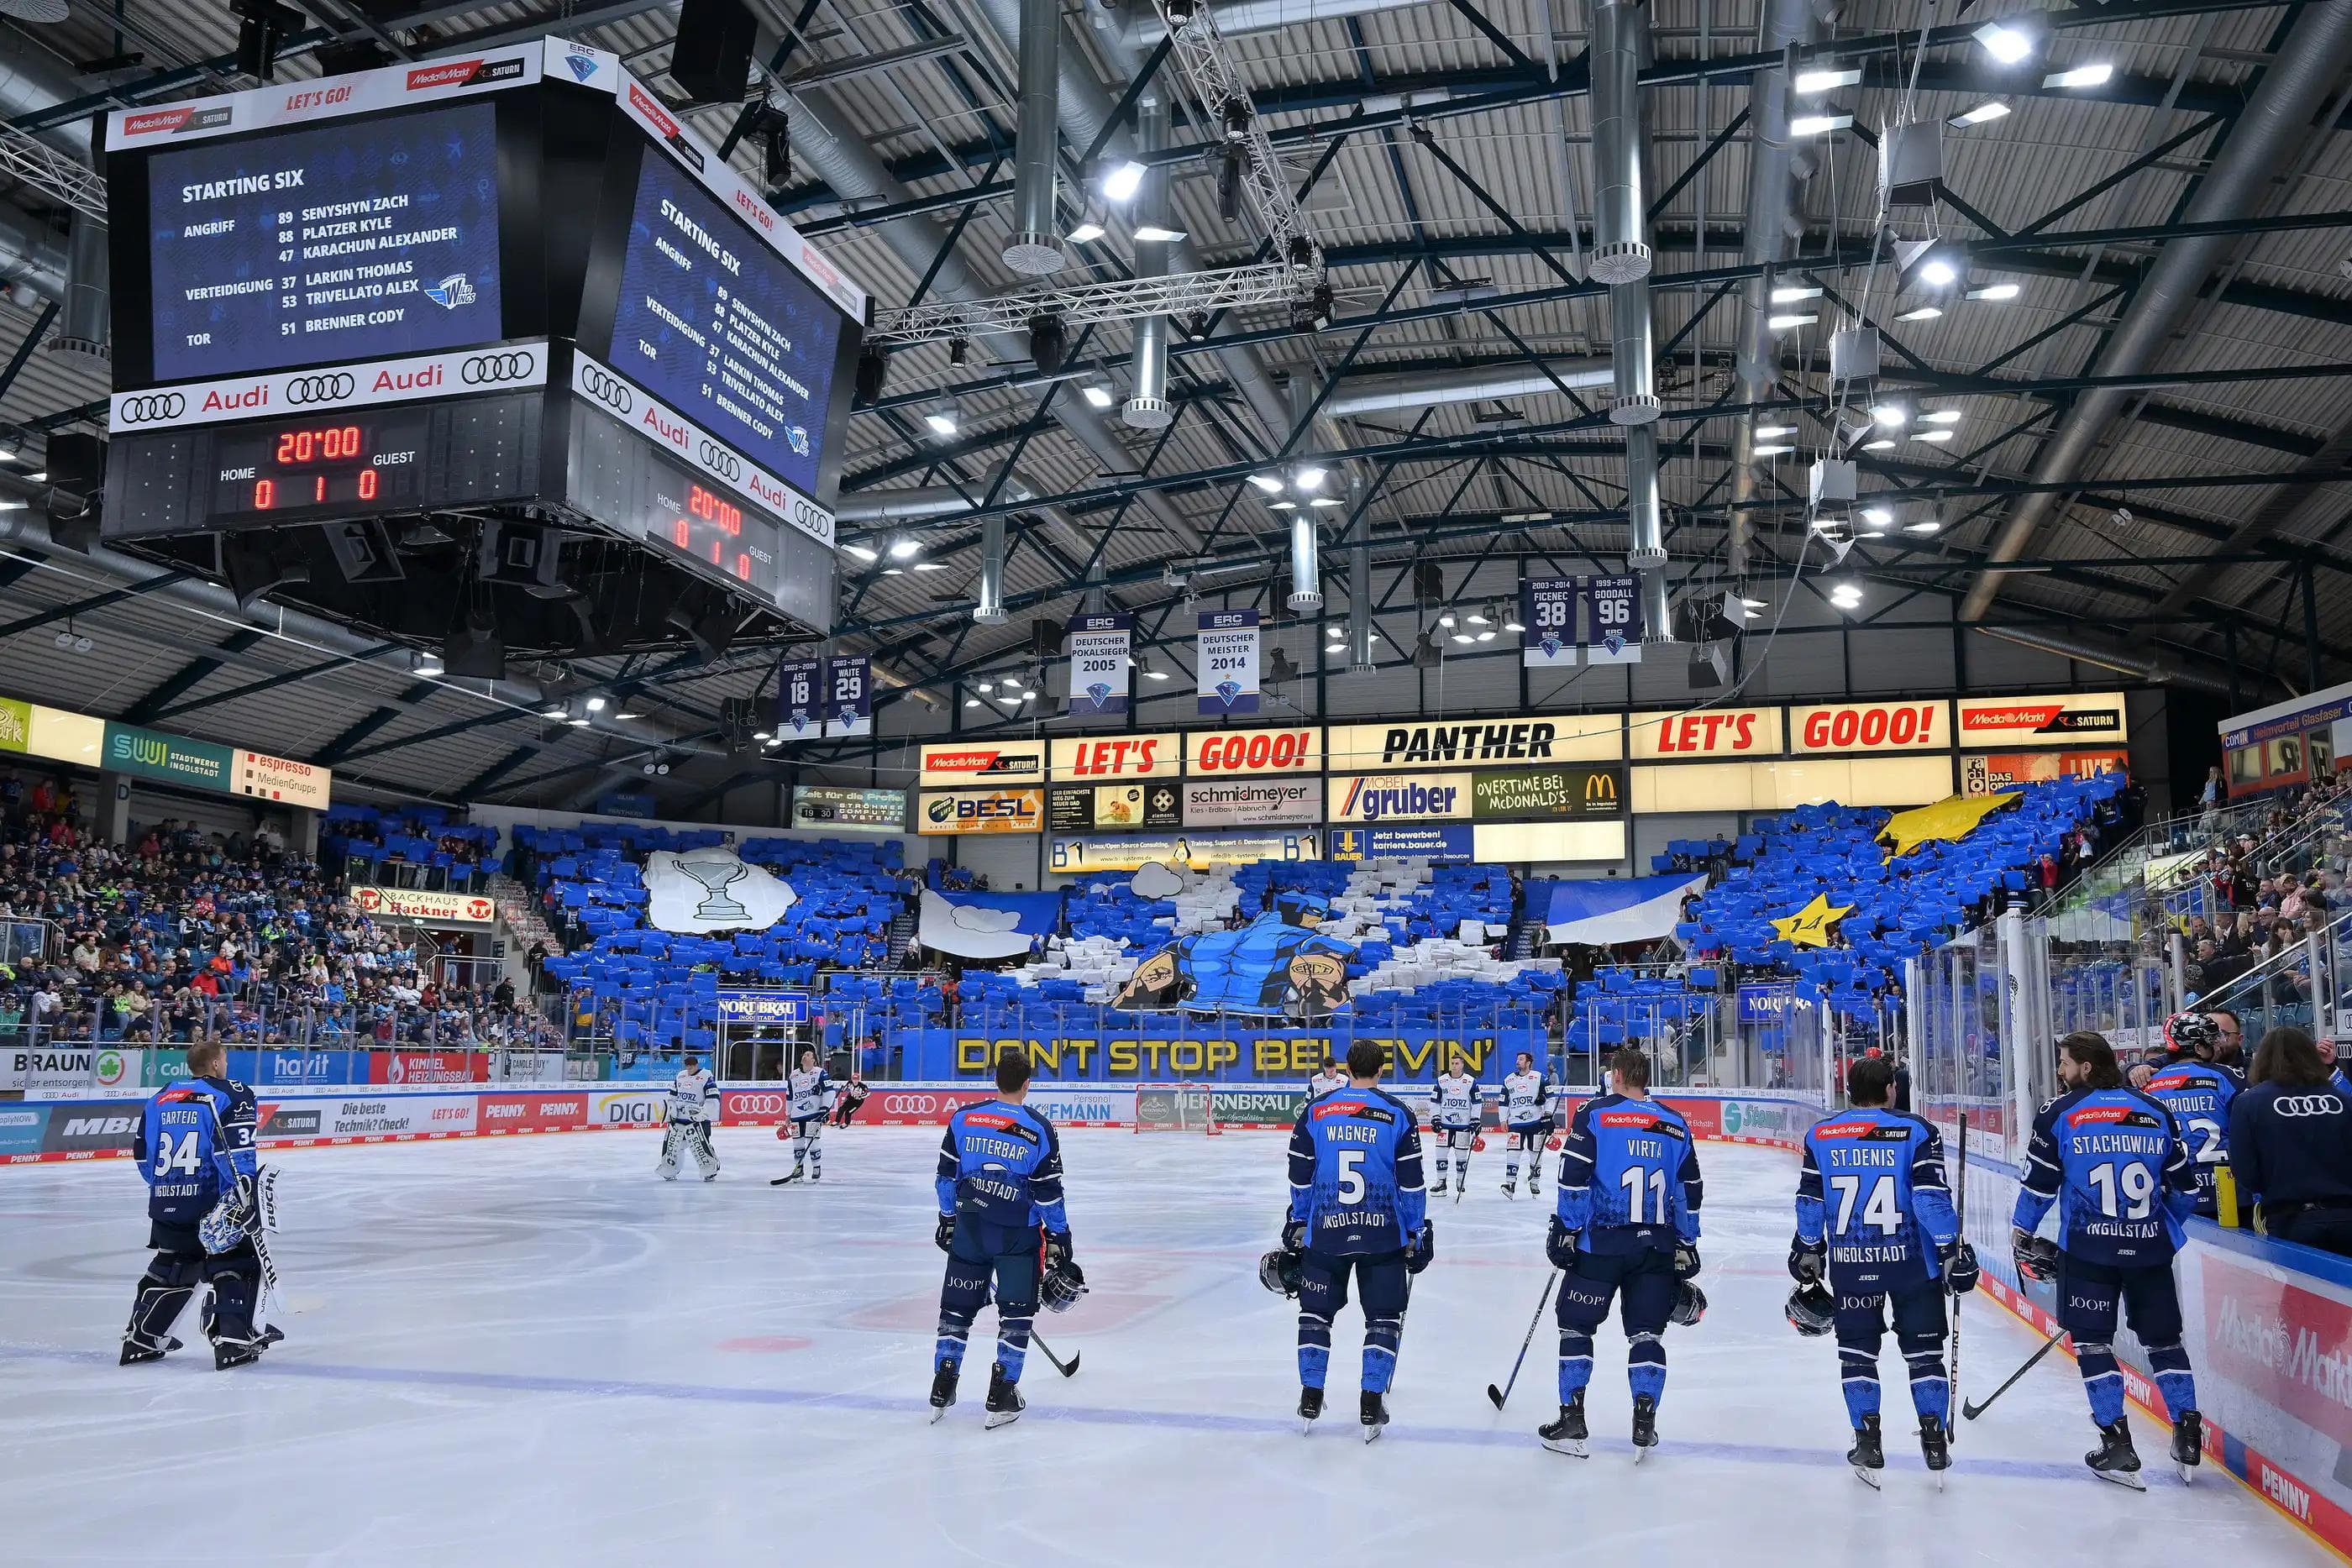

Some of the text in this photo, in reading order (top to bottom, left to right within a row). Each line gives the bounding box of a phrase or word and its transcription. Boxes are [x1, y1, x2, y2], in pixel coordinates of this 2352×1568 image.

[569, 44, 595, 56] ERC
[492, 64, 520, 77] SATURN
[287, 87, 351, 111] LET'S GO!
[182, 170, 304, 203] STARTING SIX
[278, 195, 408, 225] 89 SENYSHYN ZACH
[184, 219, 235, 238] ANGRIFF
[279, 217, 391, 244] 88 PLATZER KYLE
[661, 199, 742, 276] STARTING SIX
[279, 227, 458, 262] 47 KARACHUN ALEXANDER
[655, 237, 691, 271] ANGRIFF
[186, 261, 412, 301] VERTEIDIGUNG 37 LARKIN THOMAS
[282, 280, 418, 308] 53 TRIVELLATO ALEX
[282, 309, 405, 335] 51 BRENNER CODY
[647, 296, 706, 348] VERTEIDIGUNG
[732, 298, 791, 351] SENYSHYN ZACH
[186, 333, 211, 346] TOR
[729, 314, 780, 360] PLATZER KYLE
[727, 330, 809, 401] KARACHUN ALEXANDER
[372, 364, 443, 393] Audi
[724, 354, 784, 406] LARKIN THOMAS
[202, 385, 269, 412] Audi
[722, 371, 784, 423] TRIVELLATO ALEX
[717, 393, 773, 439] BRENNER CODY
[643, 406, 689, 449] Audi
[373, 452, 415, 464] GUEST
[221, 469, 255, 481] HOME
[749, 475, 786, 510] Audi
[1534, 592, 1568, 601] FICENEC
[1595, 590, 1633, 599] GOODALL
[1214, 615, 1242, 624] ERC
[1536, 601, 1566, 627] 38
[1599, 600, 1630, 624] 96
[1087, 618, 1115, 627] ERC
[1076, 637, 1124, 646] DEUTSCHER
[1203, 634, 1254, 644] DEUTSCHER
[1072, 648, 1128, 657] POKALSIEGER
[1208, 645, 1249, 654] MEISTER
[838, 669, 859, 677] WAITE
[1083, 659, 1116, 671] 2005
[1211, 657, 1246, 670] 2014
[793, 673, 806, 681] AST
[791, 682, 809, 704] 18
[837, 677, 861, 700] 29
[1804, 706, 1935, 747] GOOO!
[2076, 714, 2114, 726] SATURN
[2253, 706, 2342, 739] Heimvorteil Glasfaser
[1658, 713, 1756, 752] LET'S
[1200, 732, 1310, 771] GOOO!
[1382, 723, 1555, 763] PANTHER
[171, 752, 220, 768] STADTWERKE
[260, 755, 311, 778] espresso
[1009, 760, 1037, 770] SATURN
[1074, 739, 1158, 775] LET'S
[170, 763, 218, 778] INGOLSTADT
[2071, 758, 2113, 779] LIVE
[257, 773, 317, 795] MedienGruppe
[1365, 777, 1407, 788] MÖBEL
[1191, 786, 1306, 805] schmidmeyer
[1363, 783, 1456, 820] gruber
[958, 799, 1035, 818] BESL
[1395, 831, 1440, 839] bewerben!
[1373, 842, 1446, 850] karriere.bauer.de
[391, 892, 459, 906] BACKHAUS
[390, 902, 457, 917] Hackner
[13, 1054, 91, 1072] BRAUN
[275, 1054, 328, 1075] havit
[1109, 1040, 1237, 1071] STOP
[43, 1078, 89, 1088] entsorgen
[408, 1072, 474, 1083] HEIZUNGSBAU
[161, 1111, 197, 1125] GARTEIG
[342, 1103, 386, 1114] Die beste
[432, 1108, 469, 1120] LET'S GO!
[287, 1118, 316, 1128] SATURN
[335, 1118, 409, 1132] Technik? Check!
[1327, 1125, 1377, 1144] WAGNER
[155, 1131, 201, 1177] 34
[1627, 1139, 1662, 1159] VIRTA
[2073, 1134, 2165, 1156] STACHOWIAK
[1831, 1149, 1895, 1167] ST.DENIS
[1337, 1150, 1365, 1204] 5
[1621, 1166, 1667, 1224] 11
[2089, 1161, 2155, 1219] 19
[1830, 1175, 1903, 1235] 74
[1323, 1211, 1385, 1229] INGOLSTADT
[2086, 1221, 2160, 1238] INGOLSTADT
[1833, 1245, 1906, 1262] INGOLSTADT
[1840, 1295, 1883, 1310] JOOP!
[2069, 1294, 2110, 1312] JOOP!
